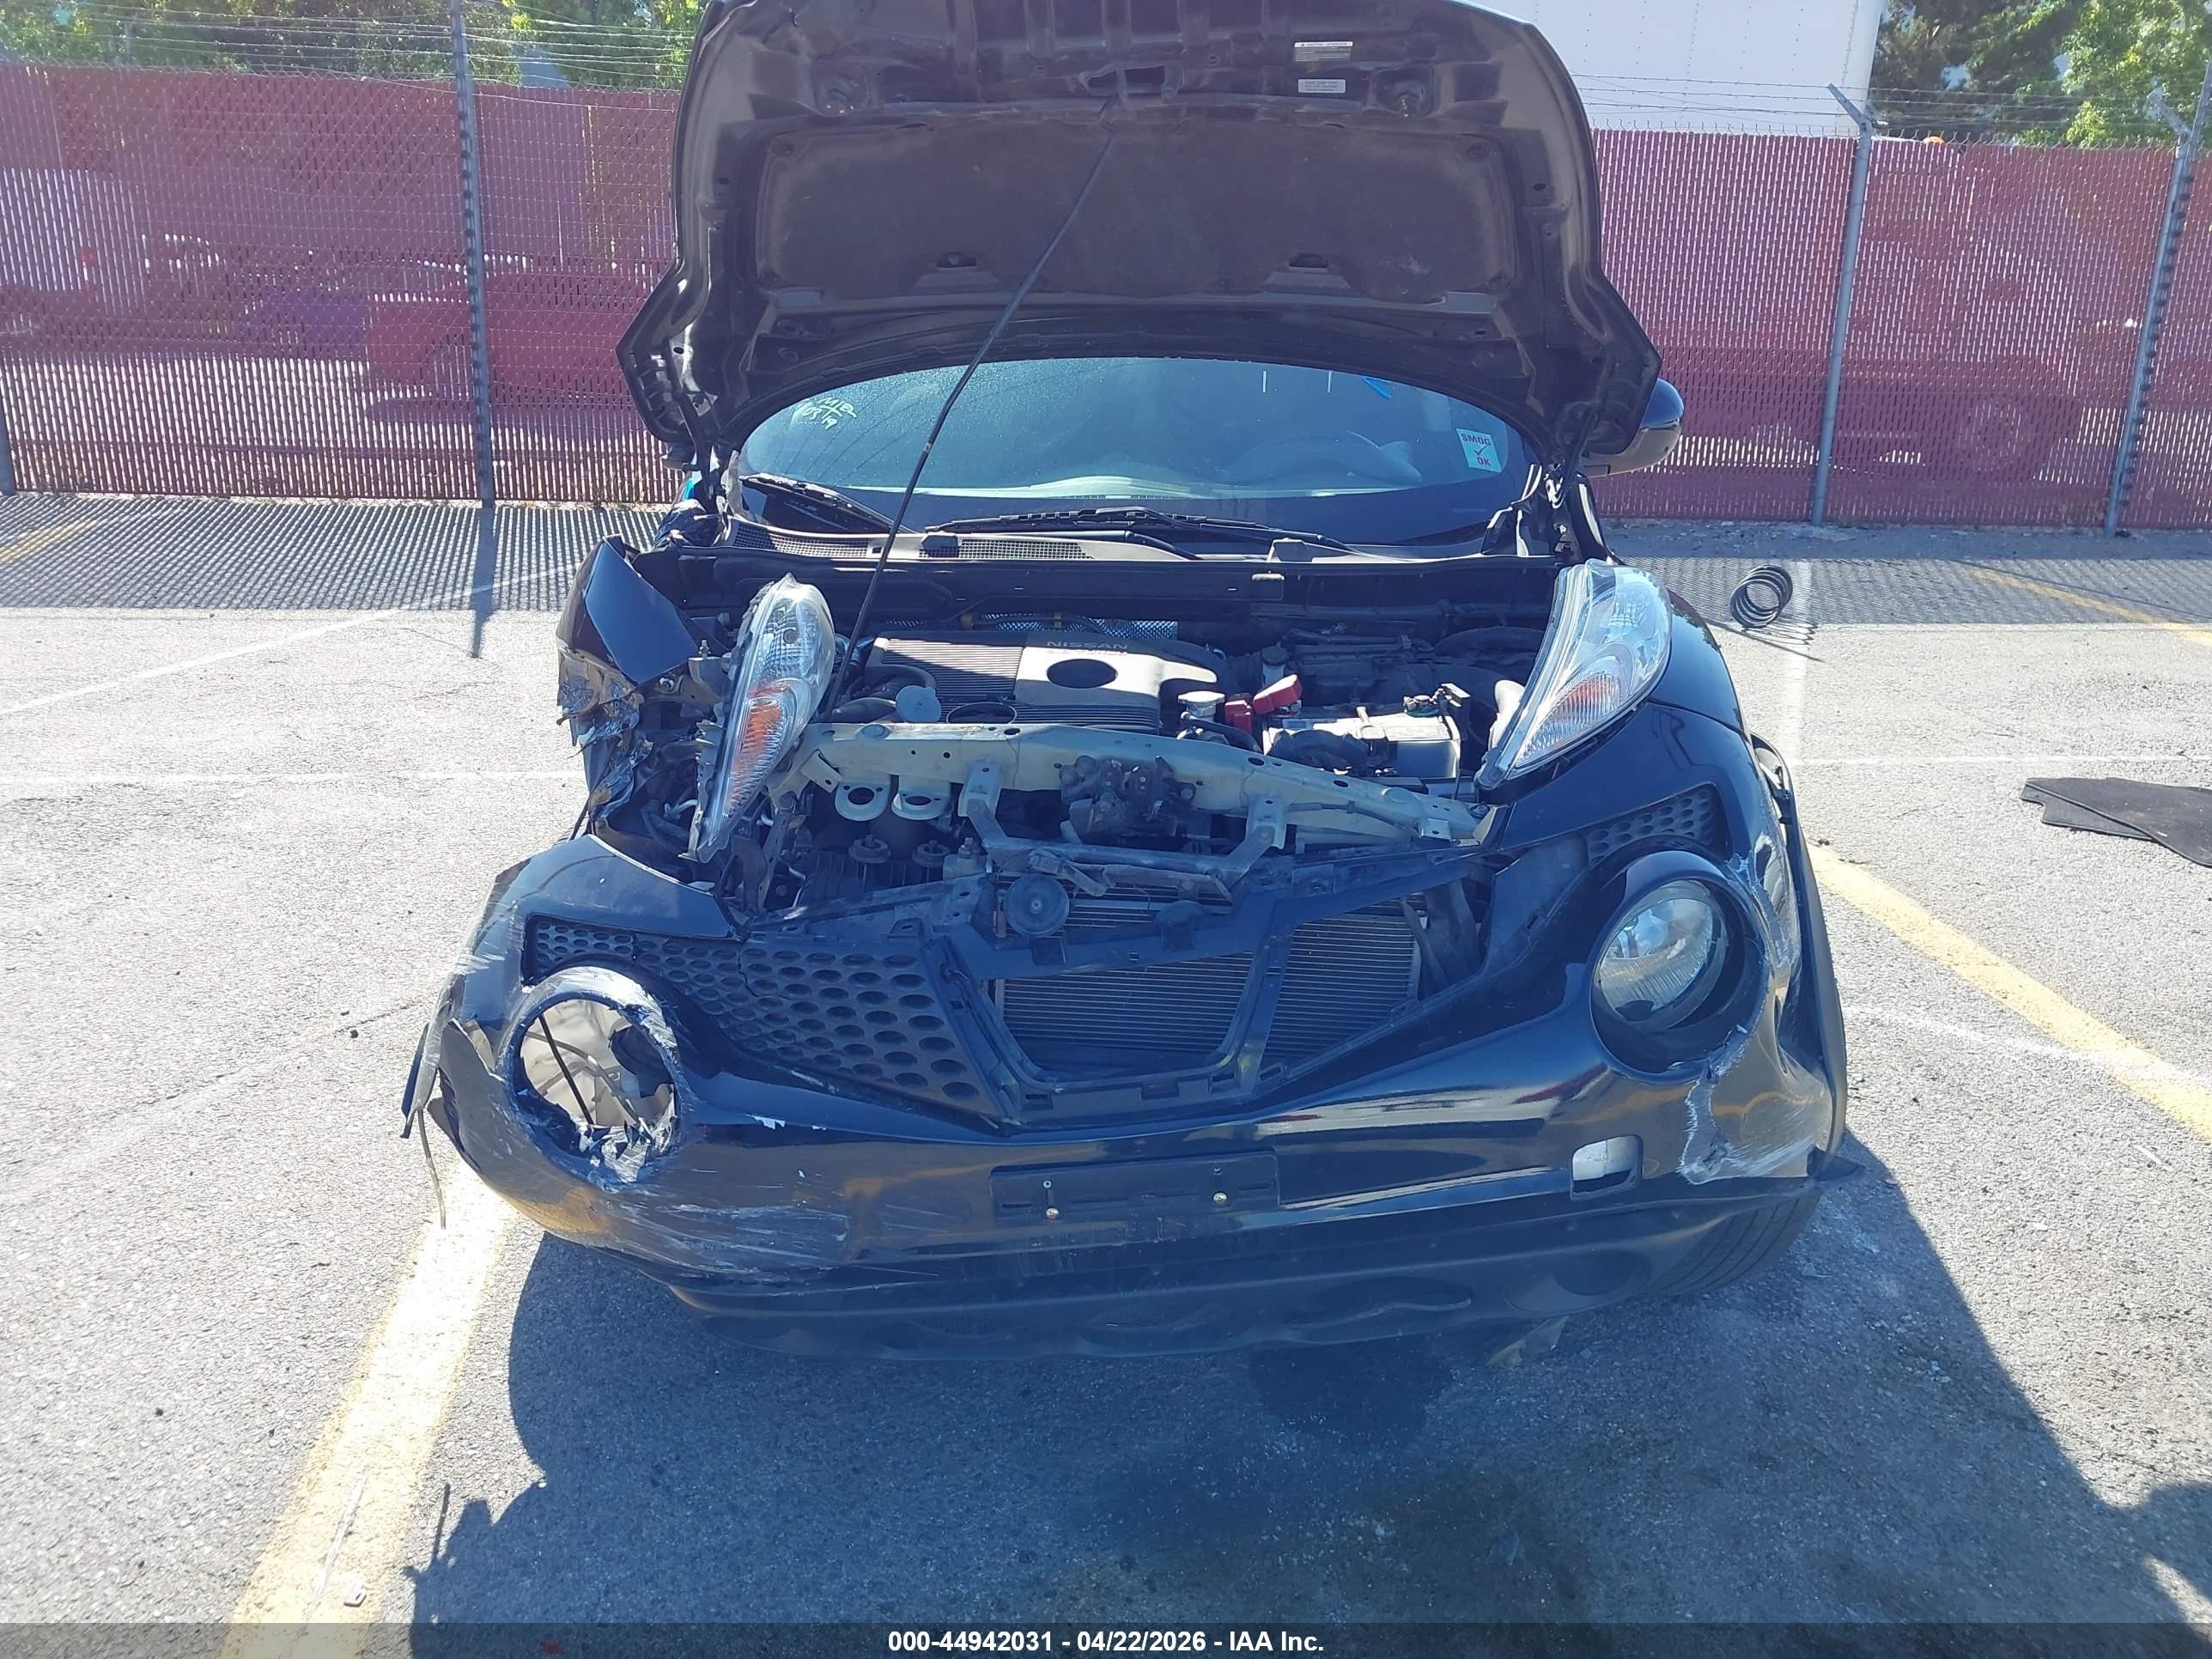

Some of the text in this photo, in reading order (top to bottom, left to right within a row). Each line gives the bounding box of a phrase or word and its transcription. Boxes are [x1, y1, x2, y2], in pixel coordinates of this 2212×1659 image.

[1461, 434, 1492, 446] SMOG
[1476, 456, 1492, 466] OK
[1047, 641, 1127, 649] NISSAN
